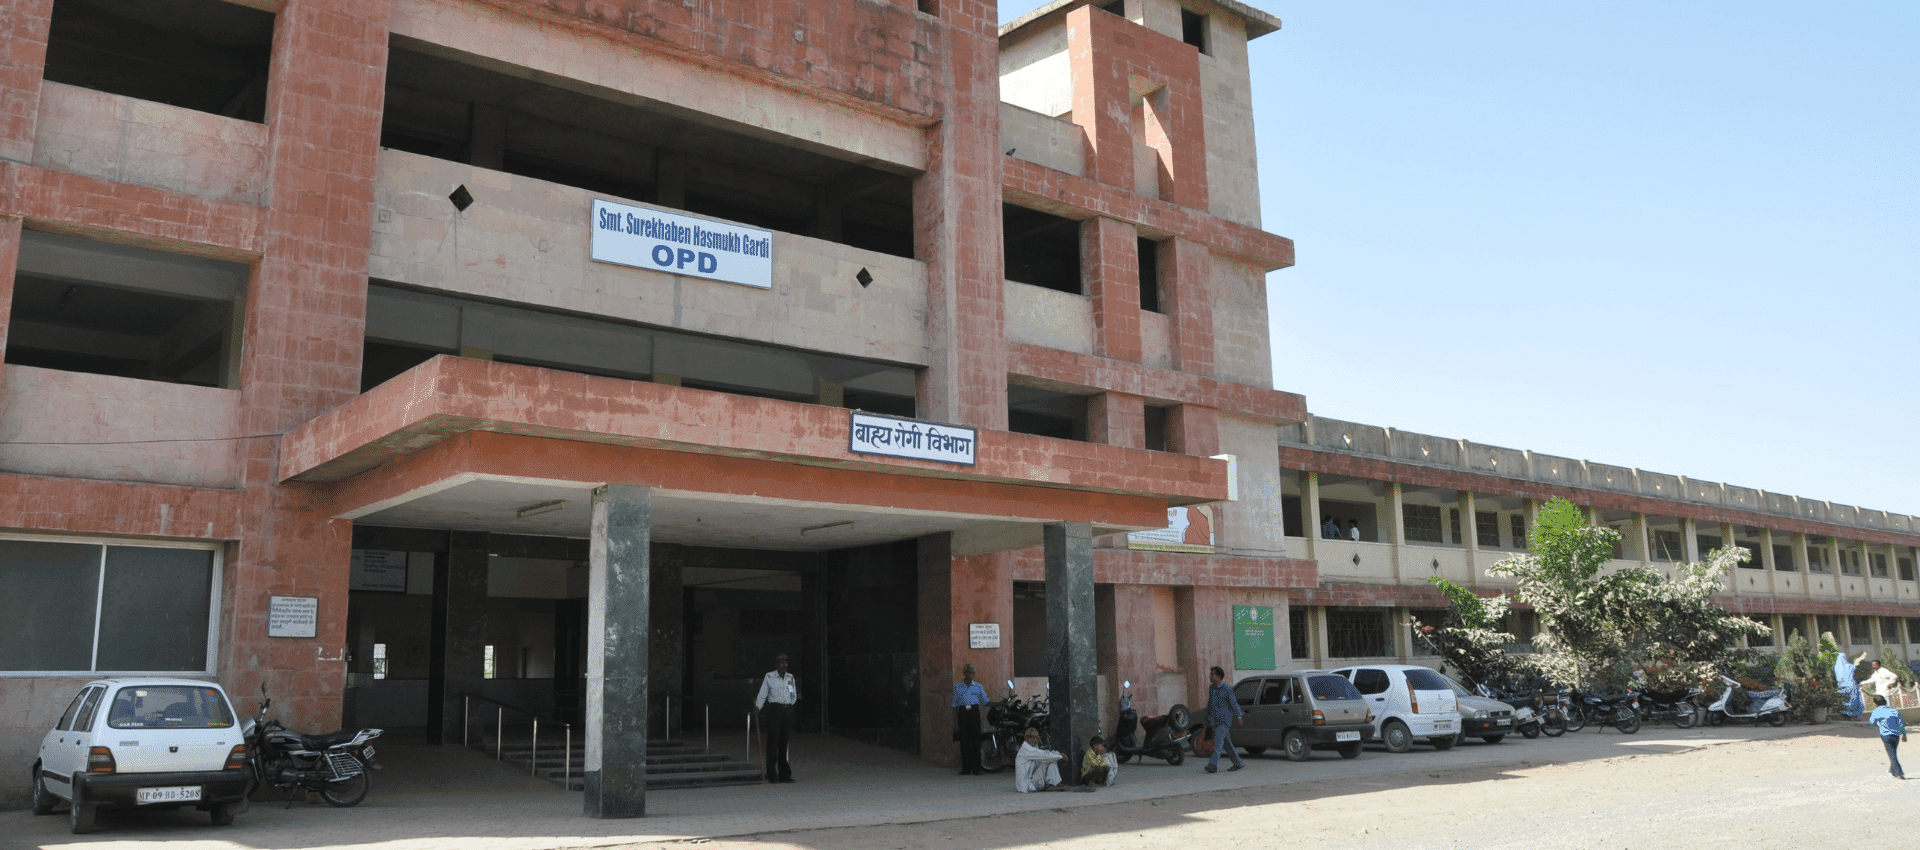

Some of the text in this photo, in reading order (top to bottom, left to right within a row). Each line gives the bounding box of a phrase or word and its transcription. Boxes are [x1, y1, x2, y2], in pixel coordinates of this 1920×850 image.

[599, 207, 770, 259] Smt. Surekhaben Hasmukh Gardi
[651, 244, 718, 274] OPD
[855, 422, 972, 455] बाह्य रोगी विभाग
